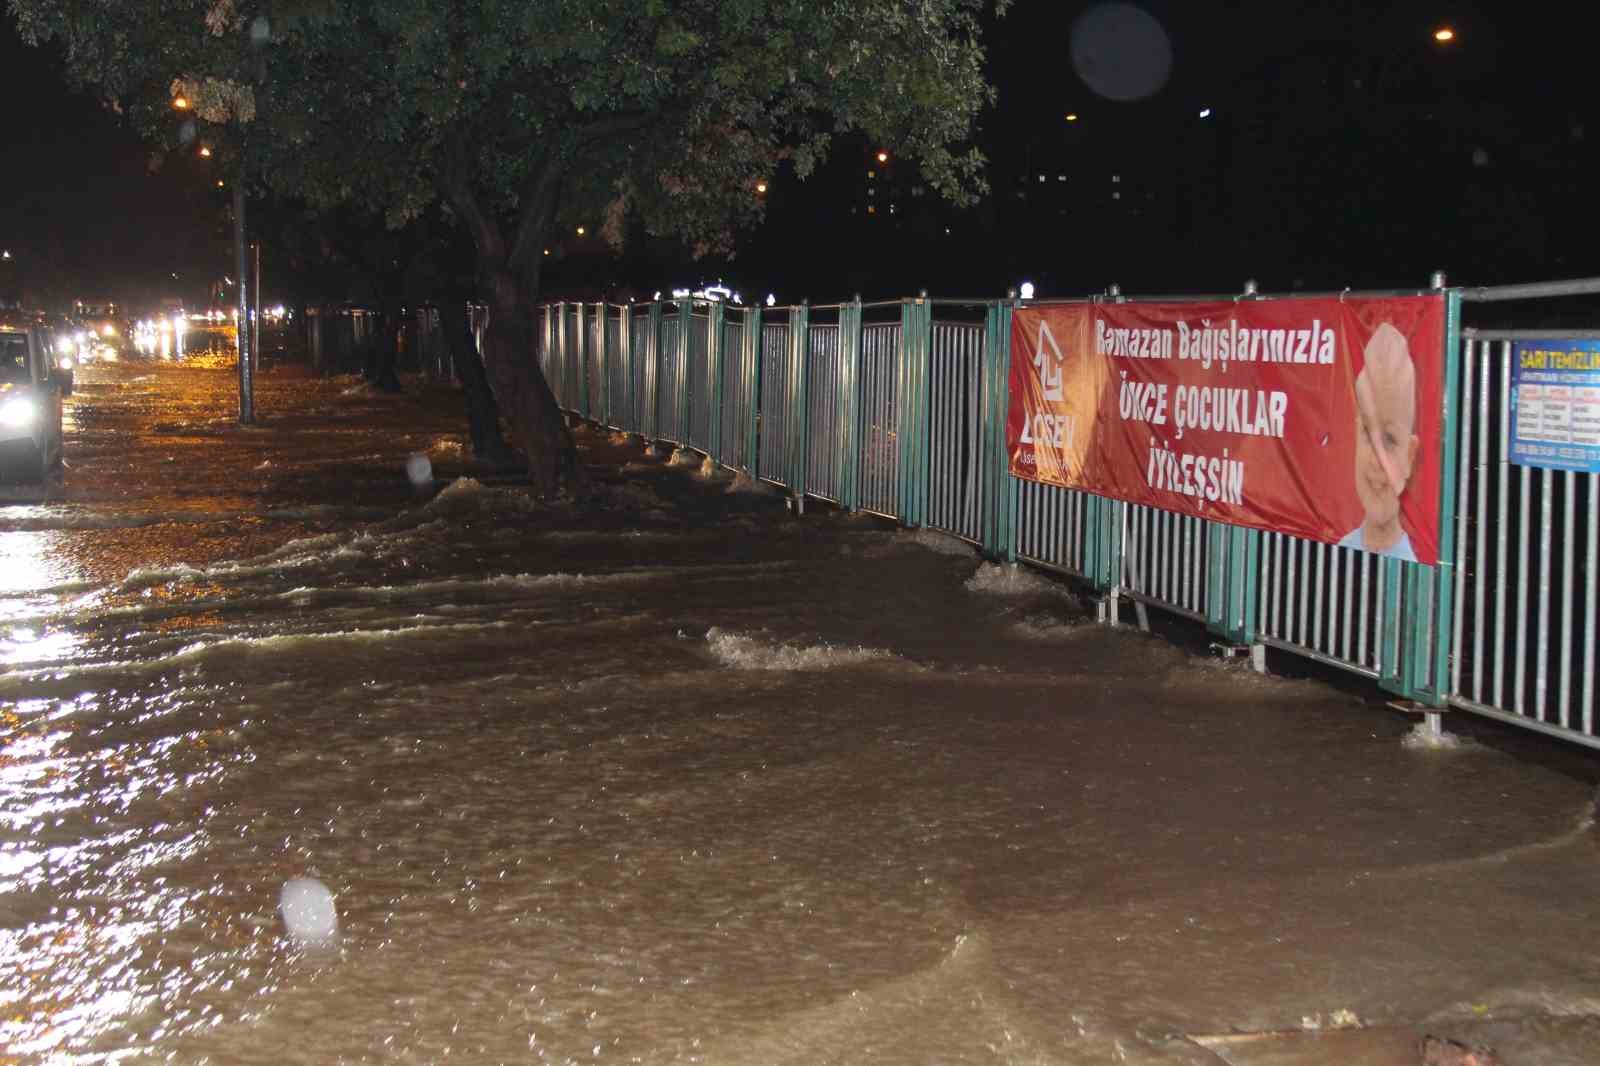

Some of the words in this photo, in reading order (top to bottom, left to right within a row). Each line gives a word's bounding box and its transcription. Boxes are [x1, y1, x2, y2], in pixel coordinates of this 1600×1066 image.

[1096, 319, 1172, 359] Ramazan
[1176, 319, 1335, 372] Bağışlarınızla
[1174, 384, 1288, 440] ÇOCUKLAR
[1147, 436, 1244, 511] İYİLEŞSİN
